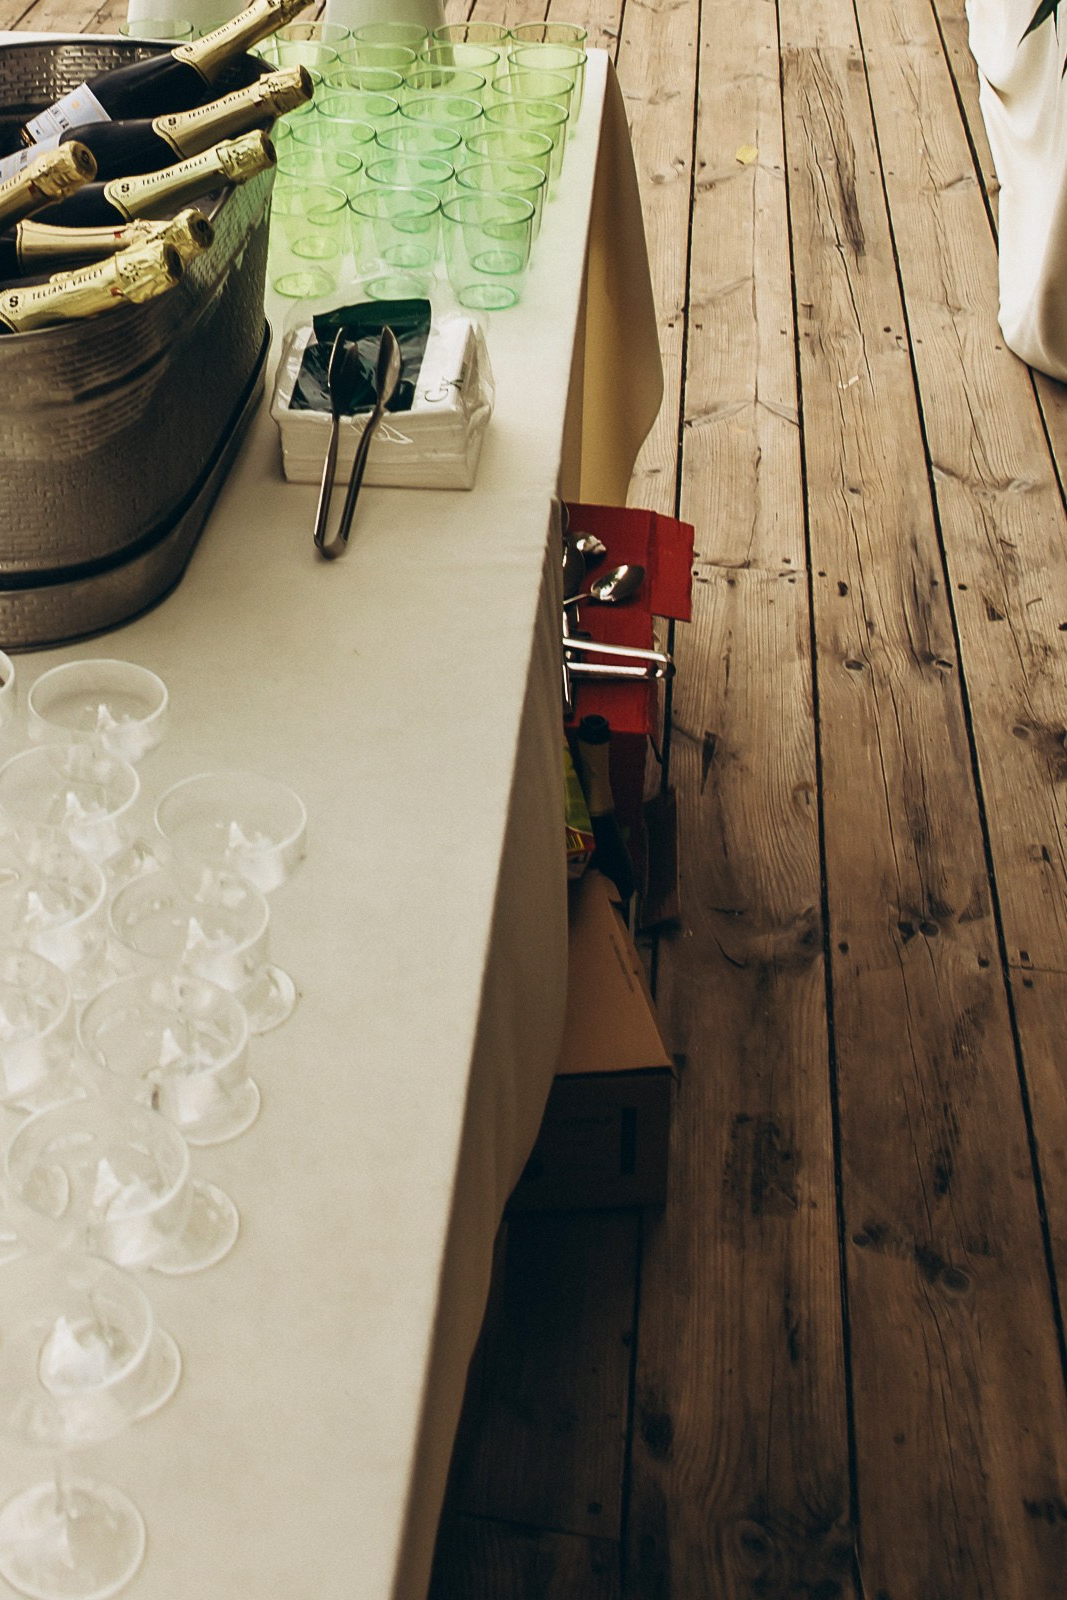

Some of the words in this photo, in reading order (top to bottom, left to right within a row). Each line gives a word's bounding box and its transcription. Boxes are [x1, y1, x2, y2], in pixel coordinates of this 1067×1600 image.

[187, 103, 220, 119] TELIANI
[222, 89, 251, 105] VALLEY
[142, 170, 175, 187] TELIANI
[178, 156, 209, 174] VALLEY
[32, 285, 68, 300] TELIANI
[72, 268, 104, 288] VALLEY
